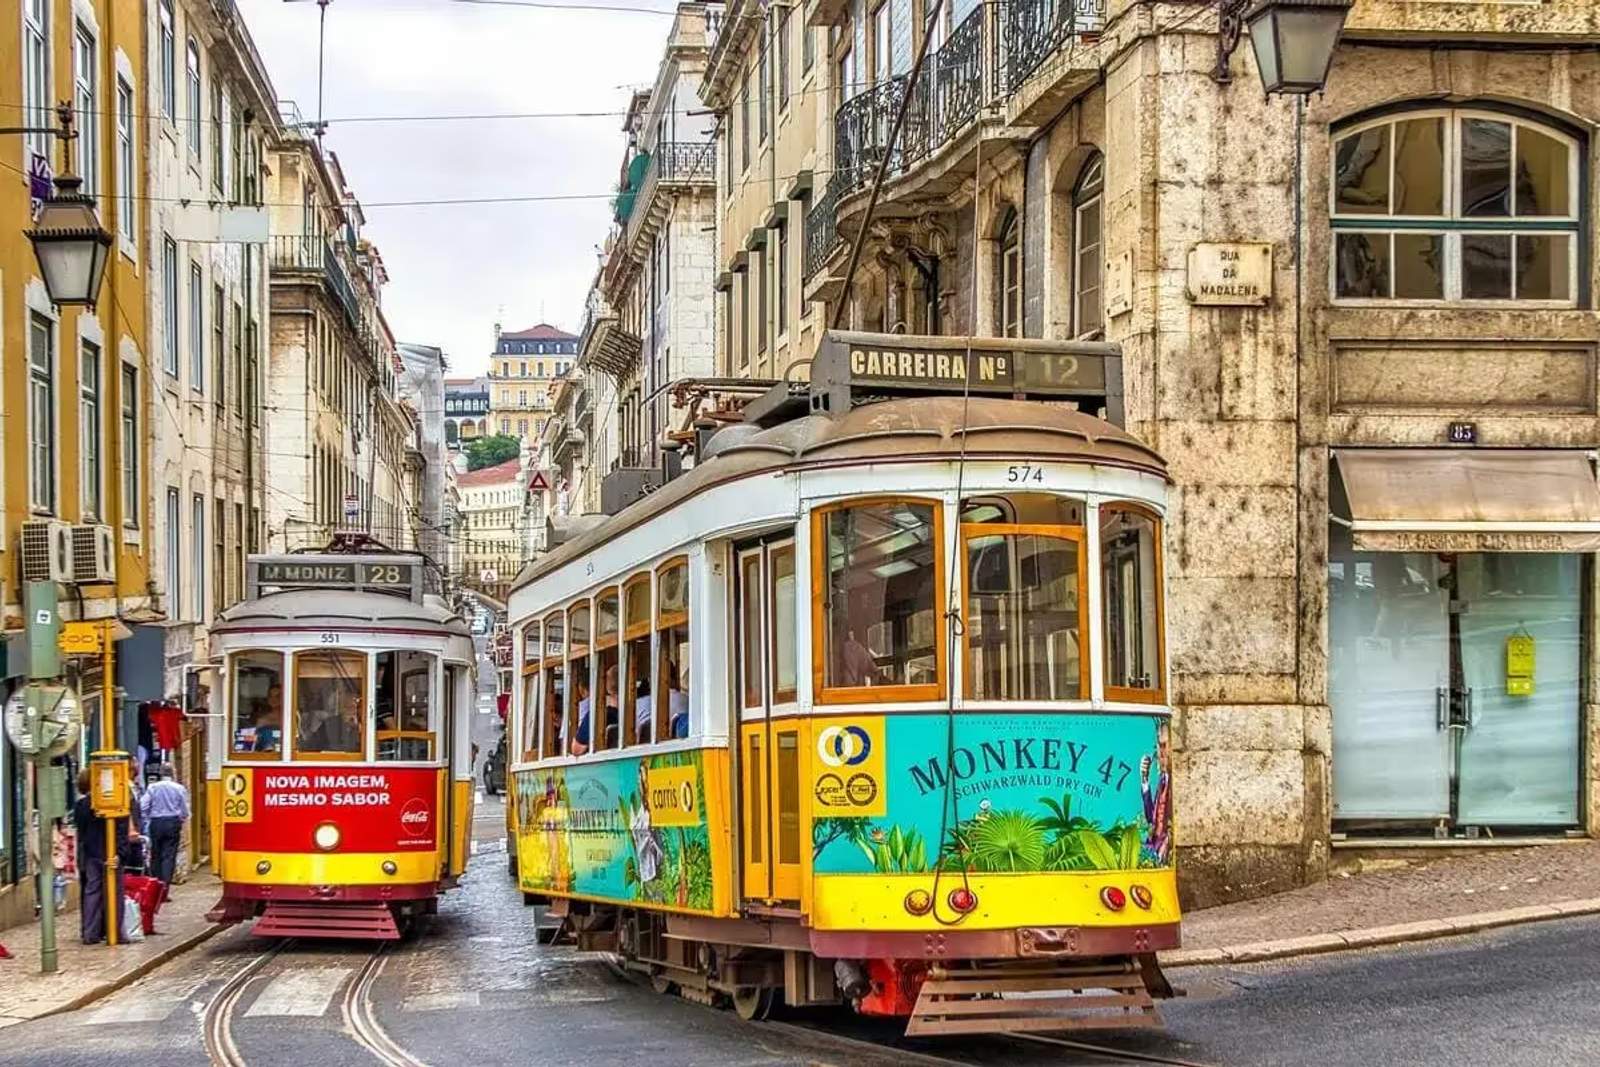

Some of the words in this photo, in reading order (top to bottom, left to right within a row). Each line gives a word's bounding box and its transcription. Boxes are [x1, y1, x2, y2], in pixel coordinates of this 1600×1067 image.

[1221, 250, 1240, 261] RUA
[1223, 268, 1237, 279] DA
[1201, 285, 1258, 296] MADALENA
[851, 350, 966, 379] CARREIRA
[1041, 355, 1079, 385] 12
[1008, 465, 1043, 482] 574
[285, 566, 346, 579] MONIZ
[371, 566, 400, 583] 28
[321, 634, 340, 643] 551
[908, 738, 1088, 796] MONKEY
[1097, 755, 1132, 791] 47
[265, 776, 309, 788] NOVA
[315, 775, 390, 790] IMAGEM,
[953, 774, 1051, 800] SCHWARZWALD
[1056, 776, 1080, 791] DRY
[1083, 783, 1103, 798] GIN
[264, 793, 327, 806] MESMO
[331, 792, 390, 805] SABOR
[653, 780, 678, 809] carris
